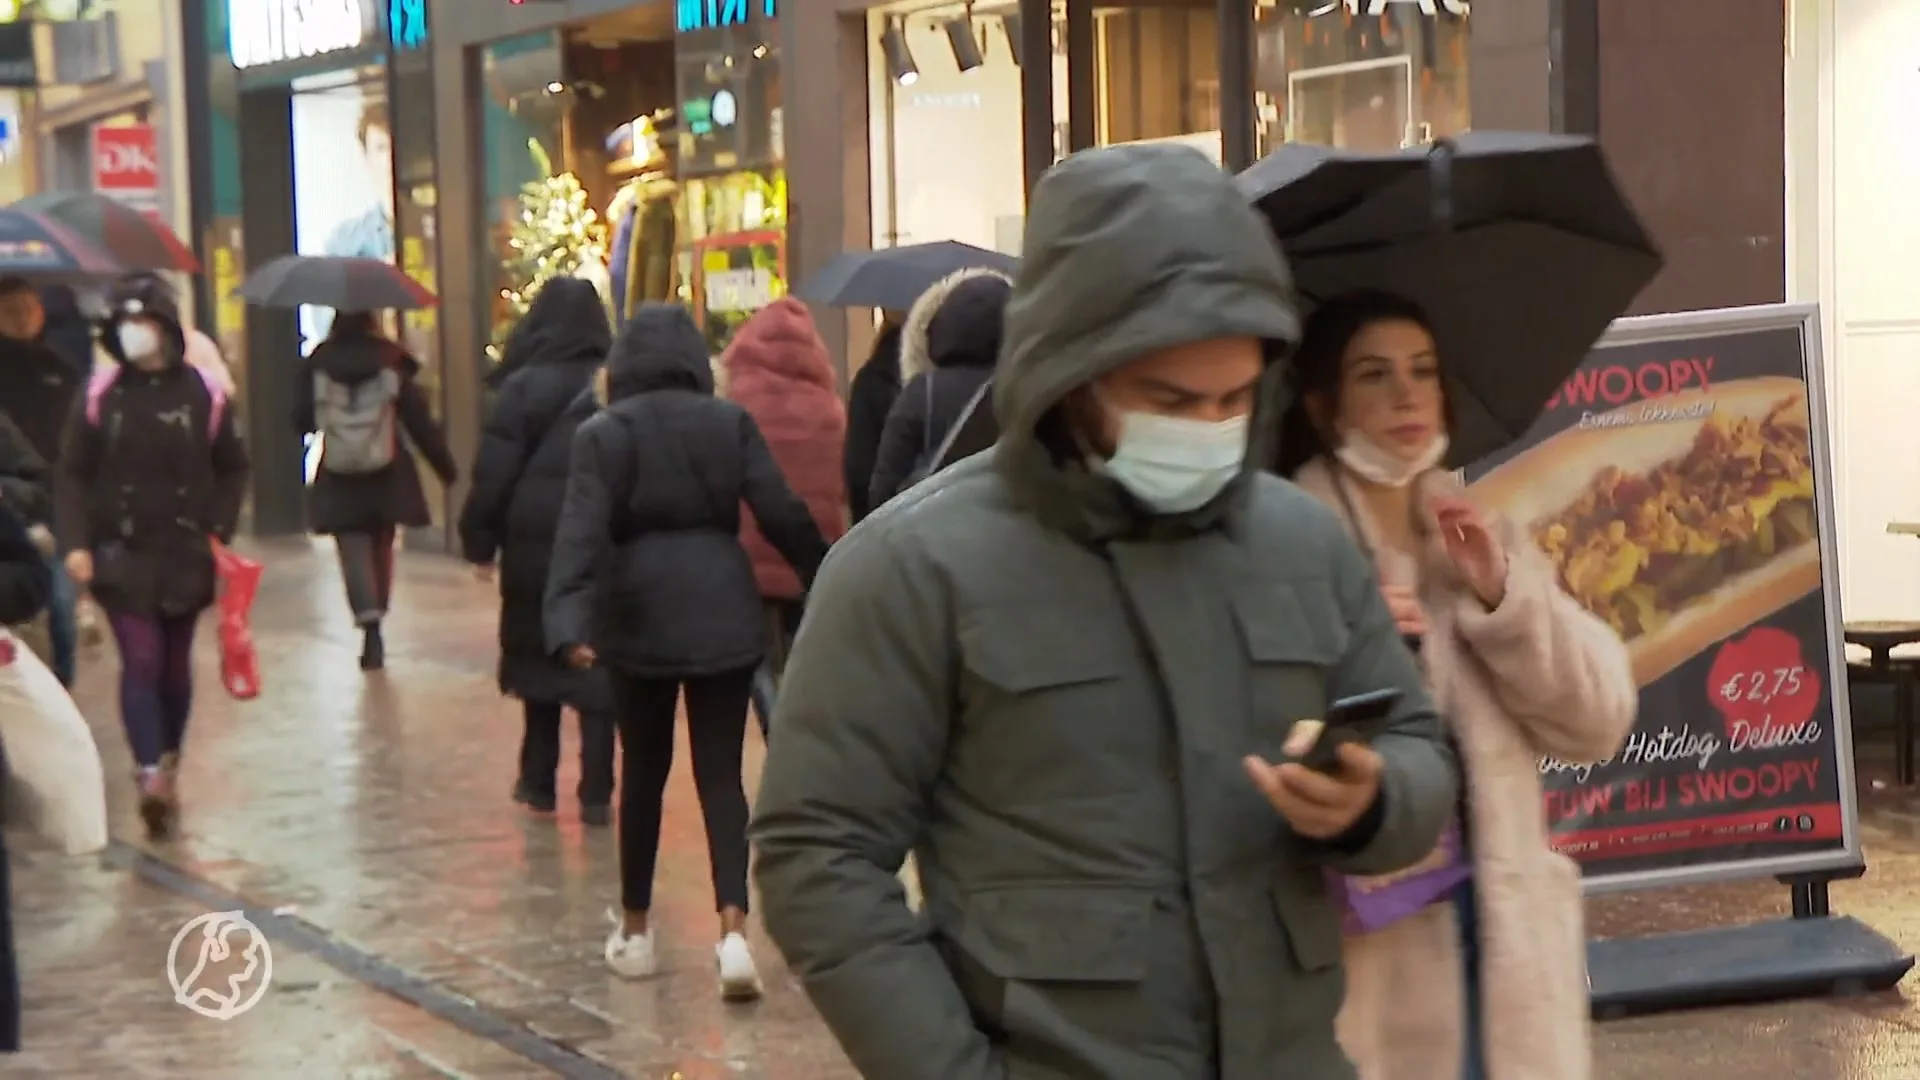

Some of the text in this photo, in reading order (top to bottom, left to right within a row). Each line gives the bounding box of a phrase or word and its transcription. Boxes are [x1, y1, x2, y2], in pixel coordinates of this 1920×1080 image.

[1622, 724, 1720, 769] Hotdog
[1730, 714, 1822, 752] Deluxe
[1679, 758, 1820, 805] SWOOPY
